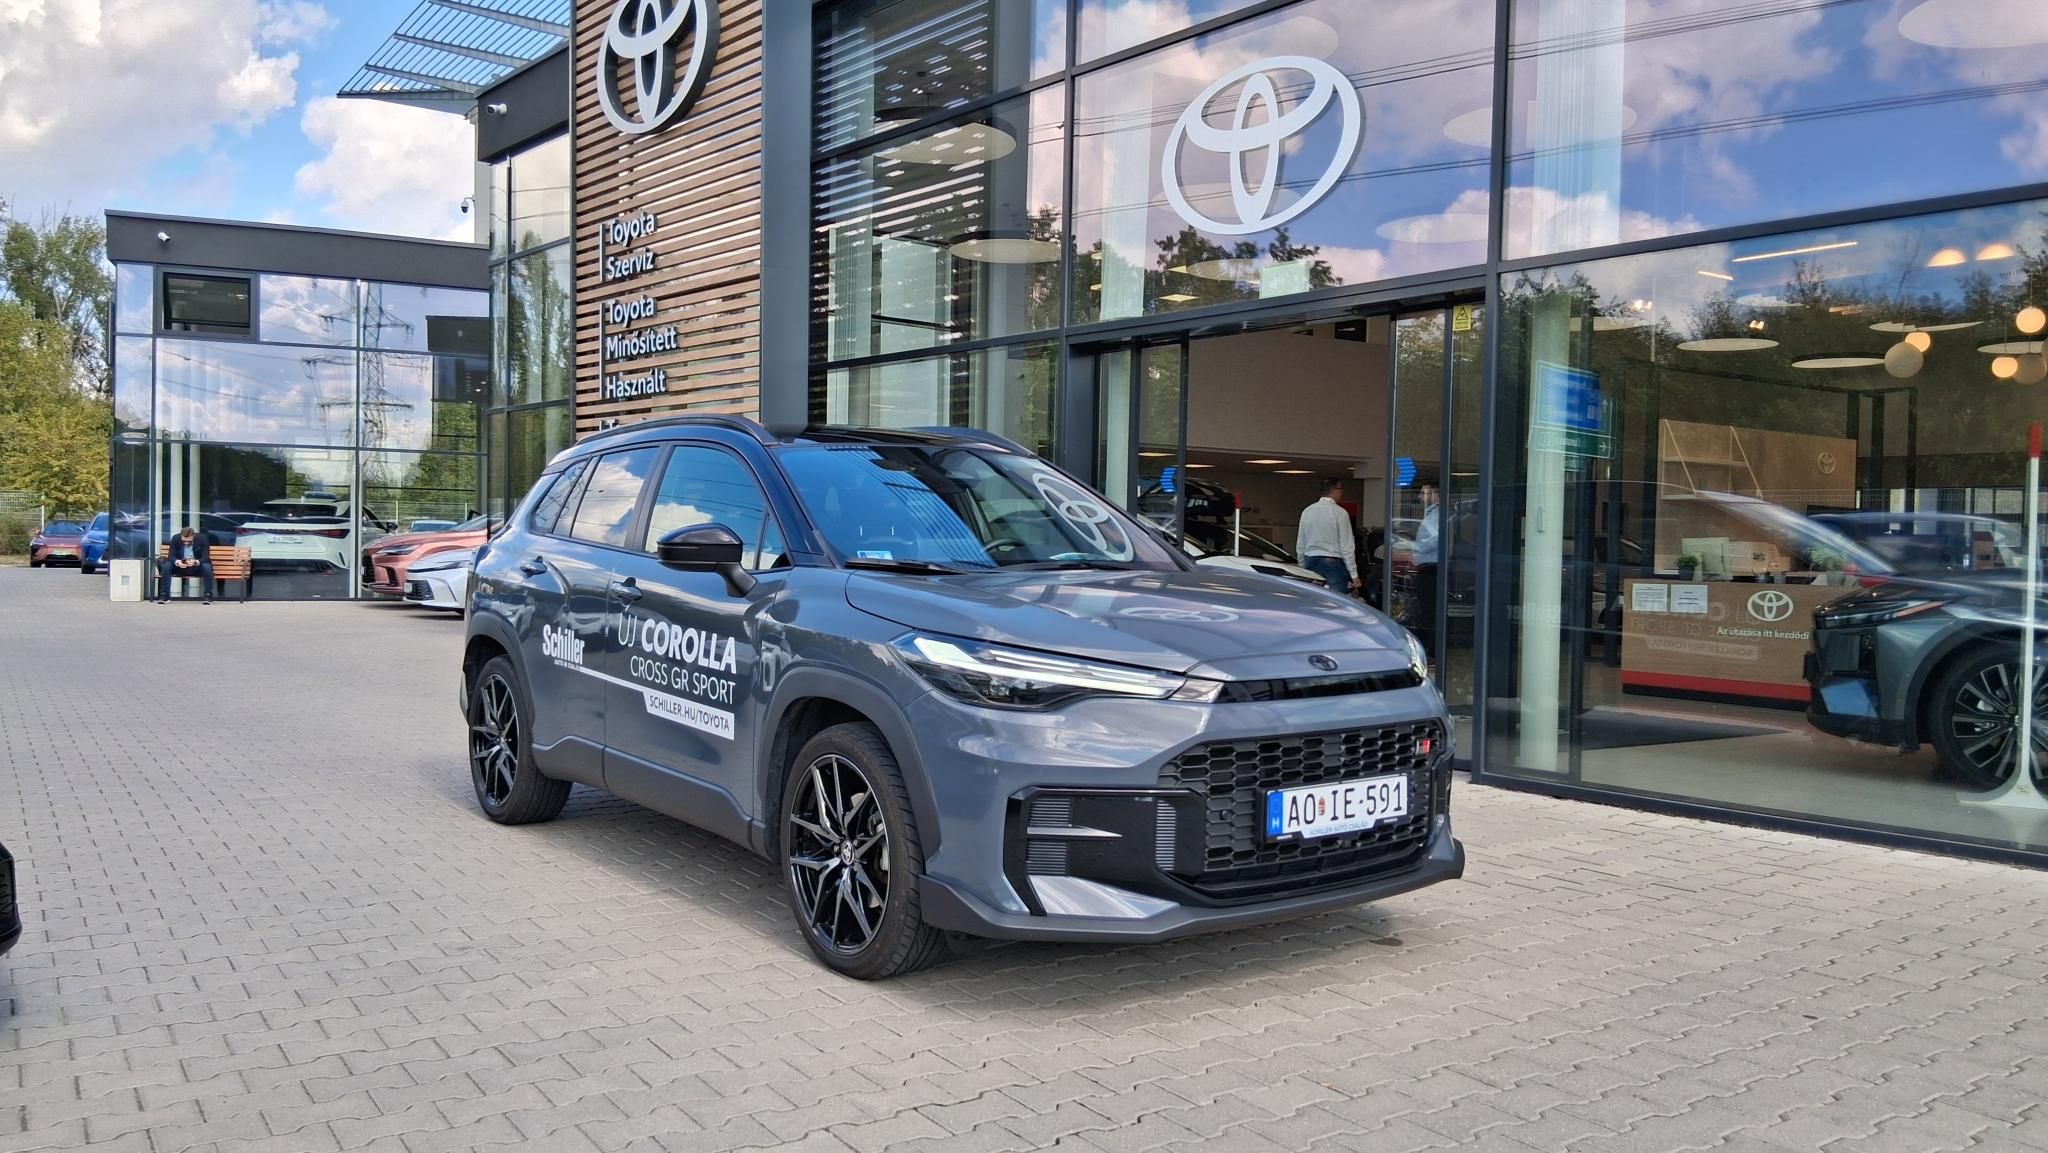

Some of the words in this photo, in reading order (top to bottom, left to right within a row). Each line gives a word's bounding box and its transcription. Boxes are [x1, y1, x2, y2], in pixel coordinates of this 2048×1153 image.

[607, 211, 656, 247] Toyota
[606, 249, 655, 280] Szerviz
[607, 295, 655, 328] Toyota
[606, 326, 678, 360] Minősített
[606, 368, 667, 399] Használt
[542, 623, 585, 666] Schiller
[641, 618, 737, 674] COROLLA
[1716, 626, 1728, 635] Az
[630, 655, 668, 686] CROSS
[671, 667, 690, 693] GR
[692, 672, 736, 705] SPORT
[649, 695, 730, 732] SCHILLER.HU/TOYOTA
